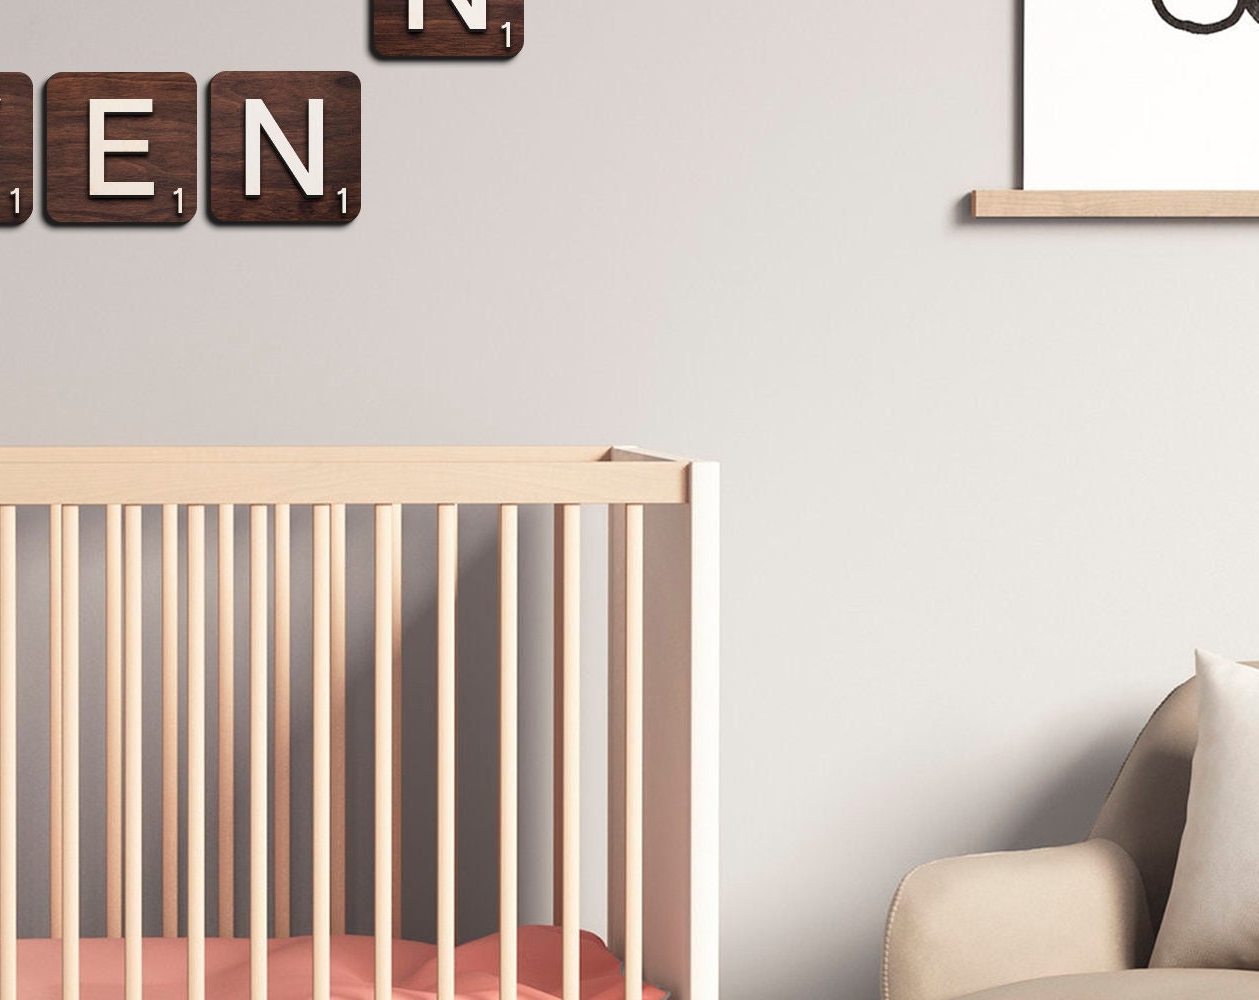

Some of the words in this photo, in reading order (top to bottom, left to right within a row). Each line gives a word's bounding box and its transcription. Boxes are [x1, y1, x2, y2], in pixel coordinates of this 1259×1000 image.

[500, 21, 511, 48] 1
[9, 187, 20, 214] 1
[172, 187, 183, 214] 1
[336, 187, 347, 214] 1
